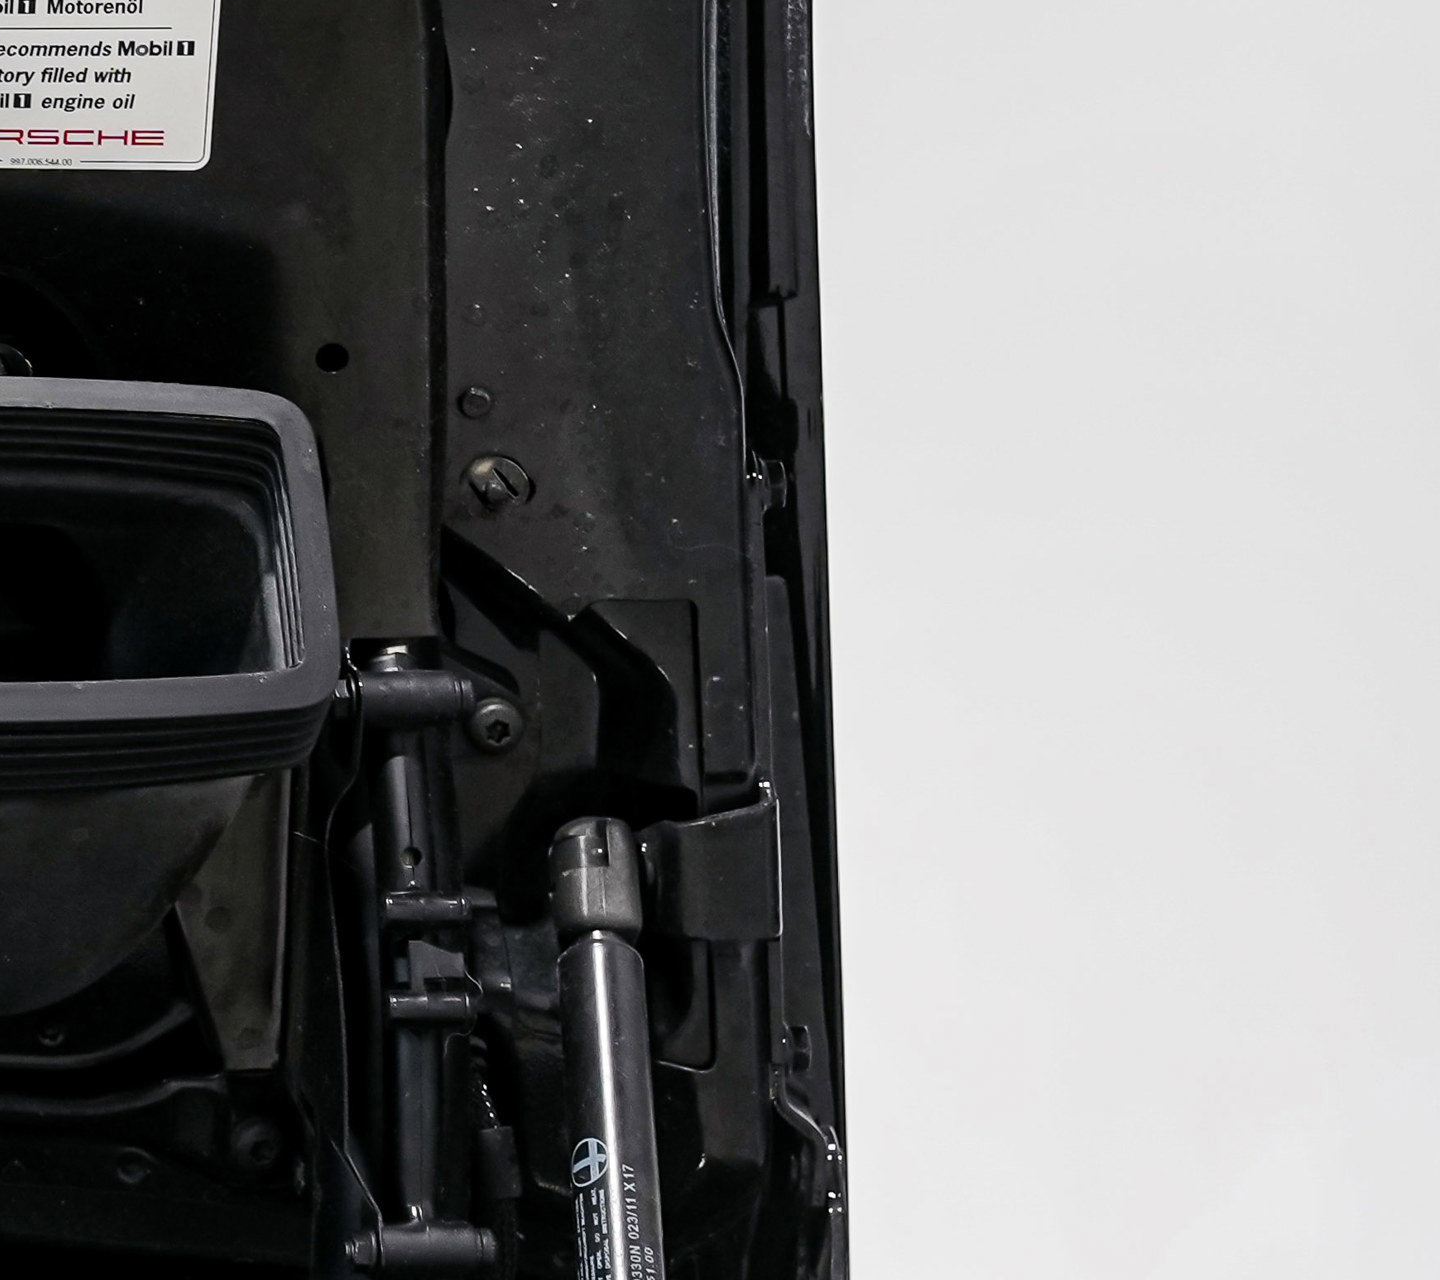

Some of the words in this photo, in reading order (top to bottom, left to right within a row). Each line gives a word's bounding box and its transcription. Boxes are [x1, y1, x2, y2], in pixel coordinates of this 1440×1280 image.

[47, 0, 143, 14] Motorenöl
[41, 68, 88, 82] filled
[95, 68, 131, 82] with
[42, 94, 104, 112] engine
[113, 94, 135, 109] oil
[625, 1198, 640, 1239] 023/11
